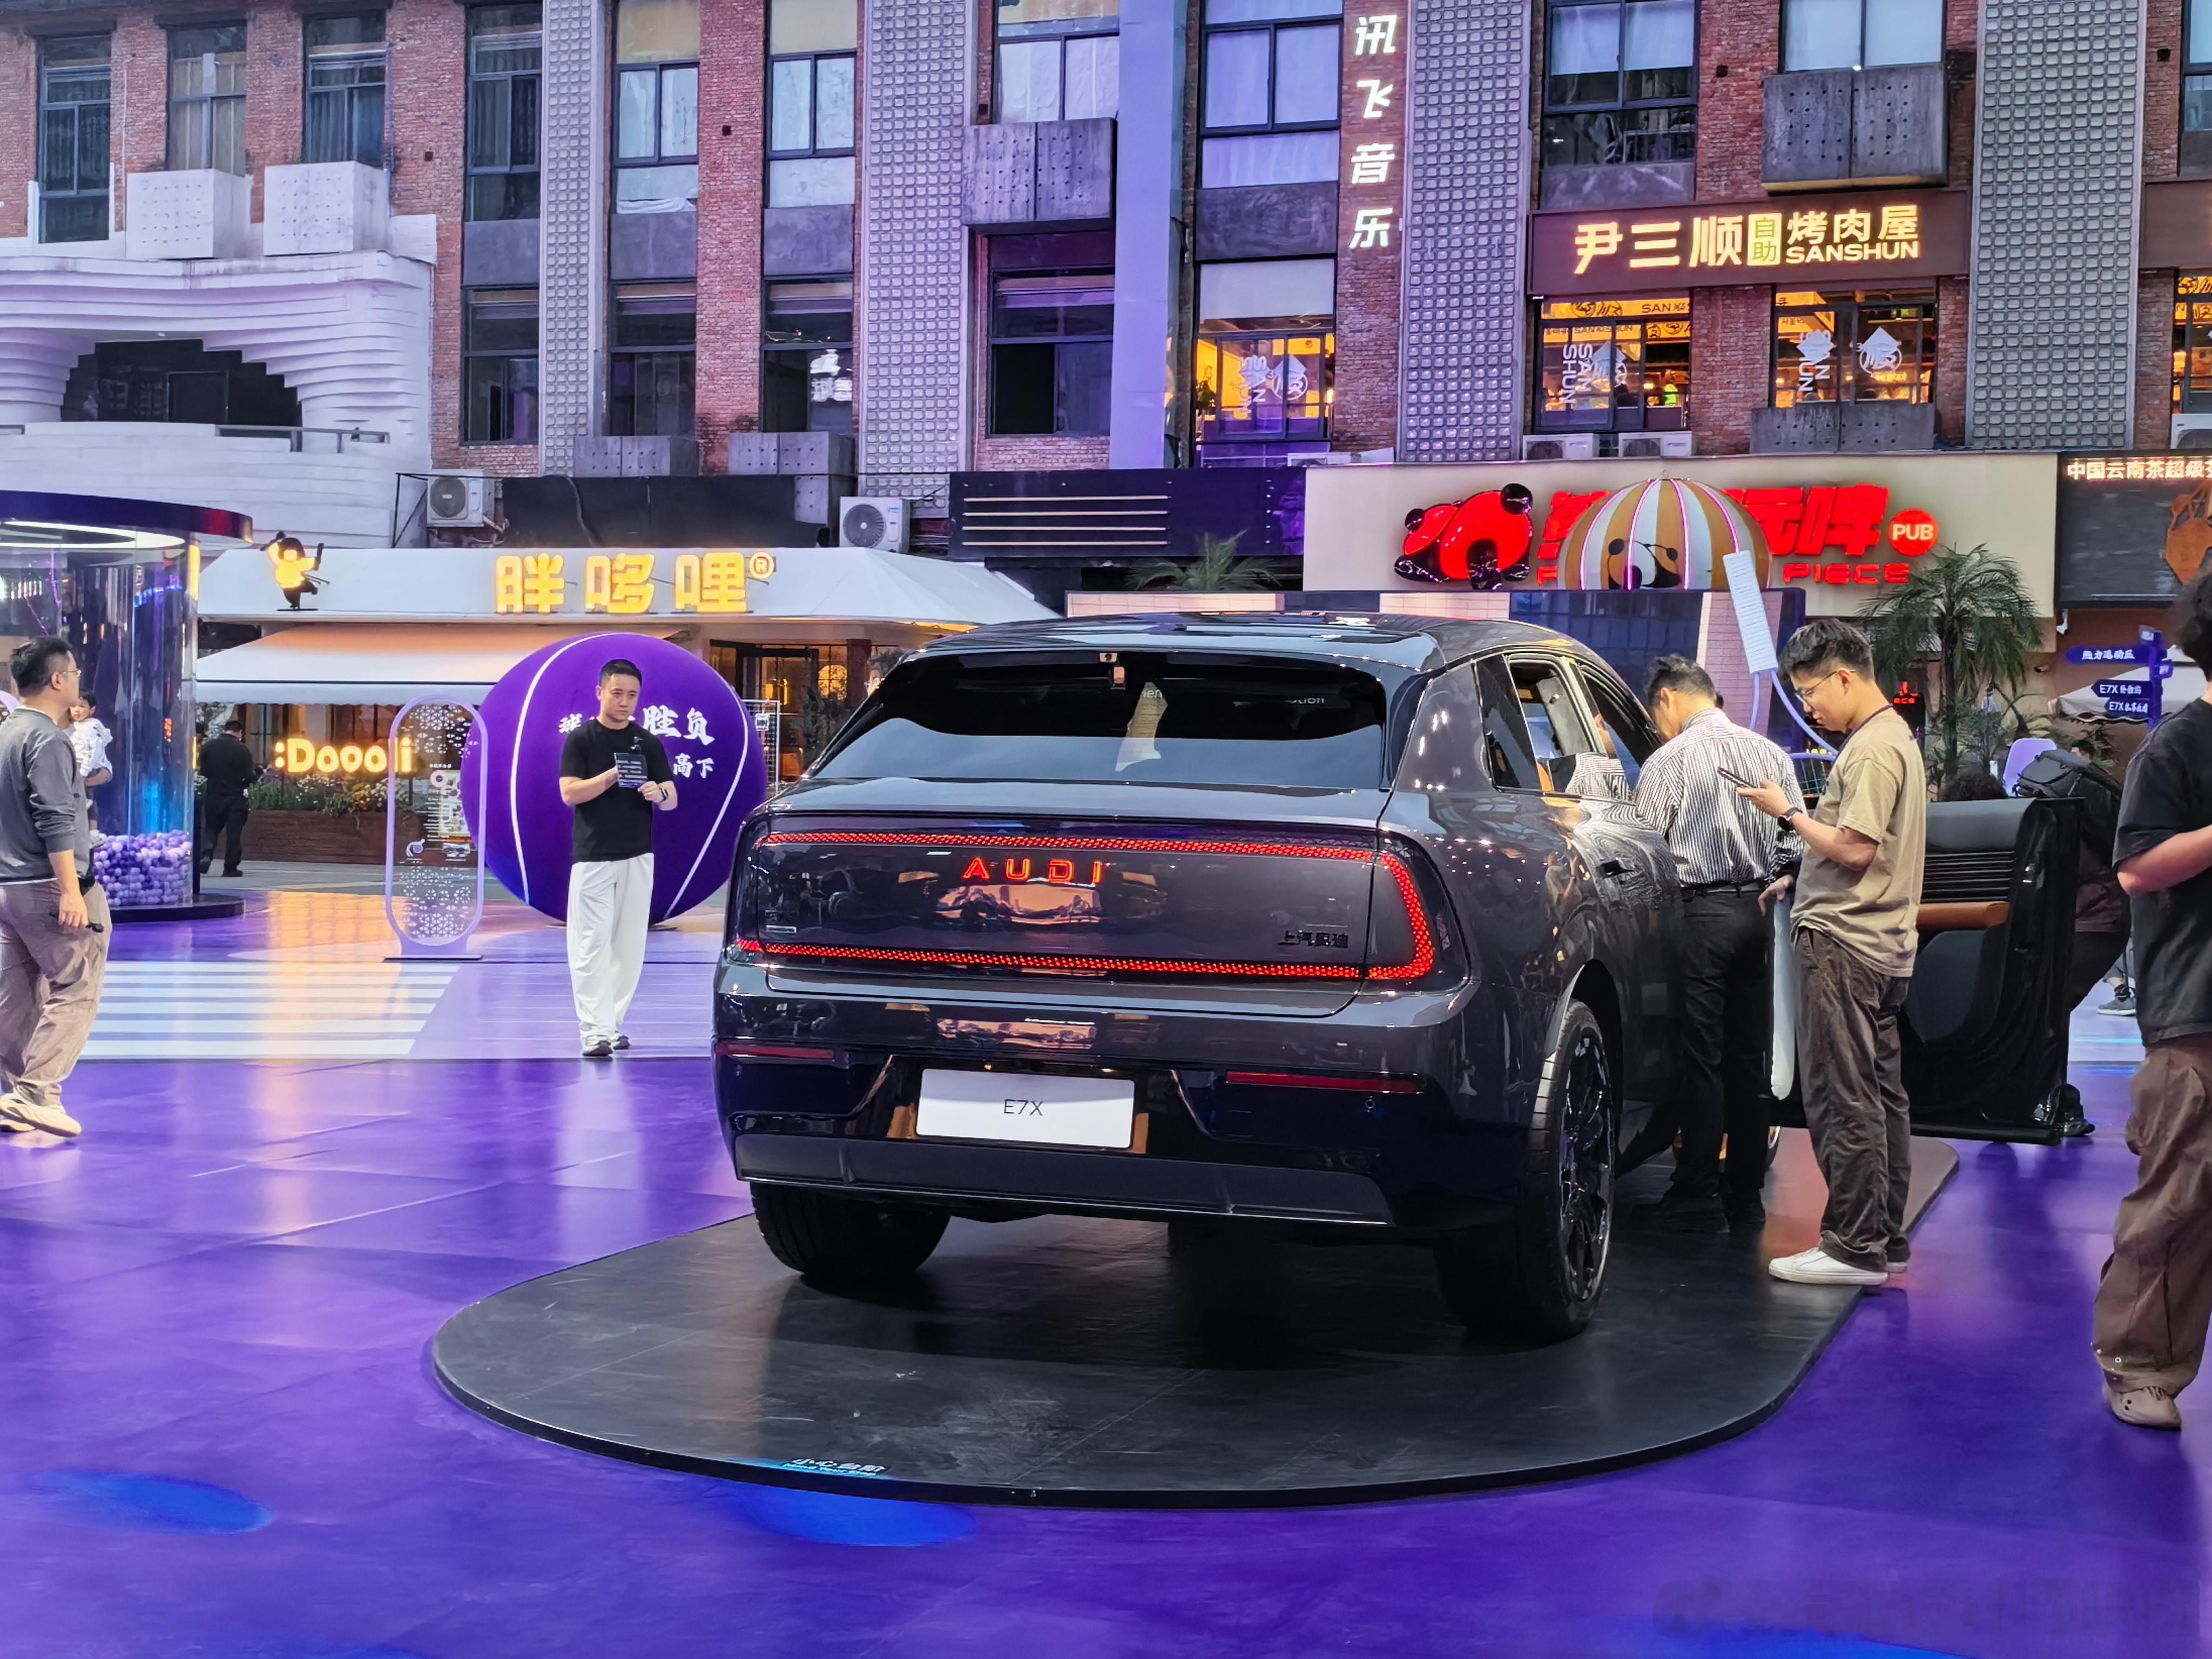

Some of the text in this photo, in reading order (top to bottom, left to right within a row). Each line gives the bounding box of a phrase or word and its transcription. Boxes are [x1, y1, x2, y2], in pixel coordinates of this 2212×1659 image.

[1349, 15, 1397, 248] 讯飞音乐
[1574, 215, 1743, 274] 尹三顺
[1786, 205, 1918, 246] 烤肉屋
[1786, 241, 1918, 264] SANSHUN
[1562, 344, 1577, 404] SHUN
[1892, 524, 1934, 541] PUB
[495, 552, 747, 613] 胖哆哩
[1783, 563, 1911, 584] PIECE
[673, 752, 715, 779] 高下
[962, 857, 1102, 884] AUDI
[1004, 1098, 1044, 1116] E7X
